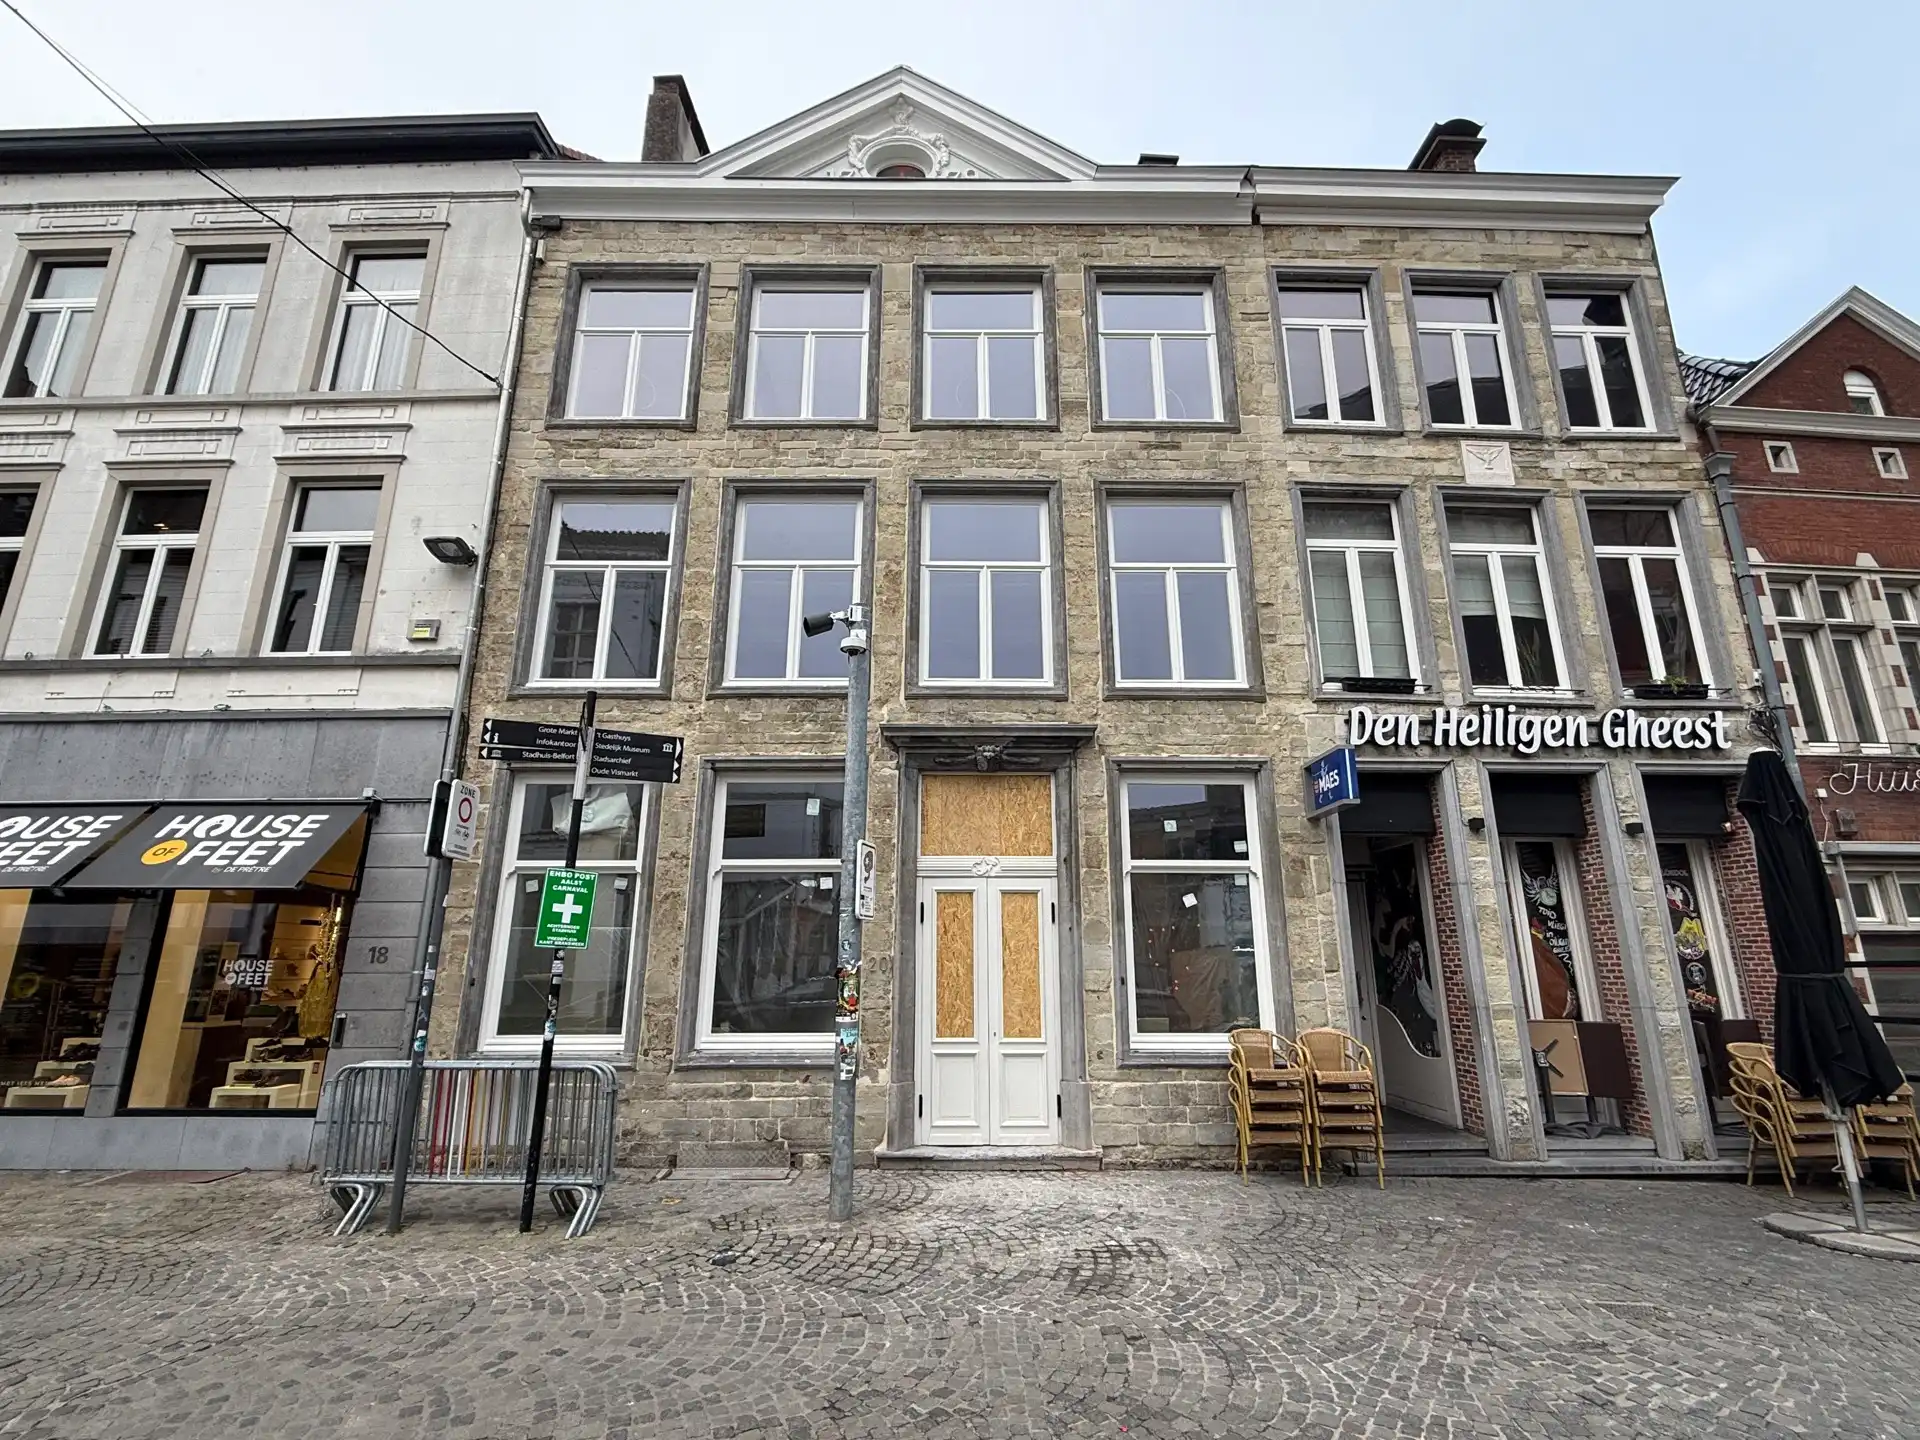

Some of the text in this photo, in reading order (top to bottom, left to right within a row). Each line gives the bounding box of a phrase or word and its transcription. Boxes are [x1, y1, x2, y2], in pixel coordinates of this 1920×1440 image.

[538, 726, 578, 736] Grote Markt
[1350, 704, 1732, 754] Den Heiligen Gheest
[536, 738, 577, 748] Infokantoor
[602, 732, 631, 742] Gasthuys
[595, 742, 651, 754] Stedelijk Museum
[522, 750, 575, 760] Stadhuis-Belfort
[593, 755, 632, 765] Stadsarchief
[591, 767, 639, 777] Oude Vismarkt
[1318, 769, 1340, 794] MAES
[460, 784, 477, 799] ZONE
[154, 814, 330, 839] HOUSE
[0, 840, 91, 866] EET
[151, 840, 305, 866] OF FEET
[552, 885, 589, 893] CARNAVAL
[368, 946, 389, 964] 18
[223, 960, 274, 972] HOUSE
[869, 956, 888, 972] 20
[237, 972, 272, 985] FEET
